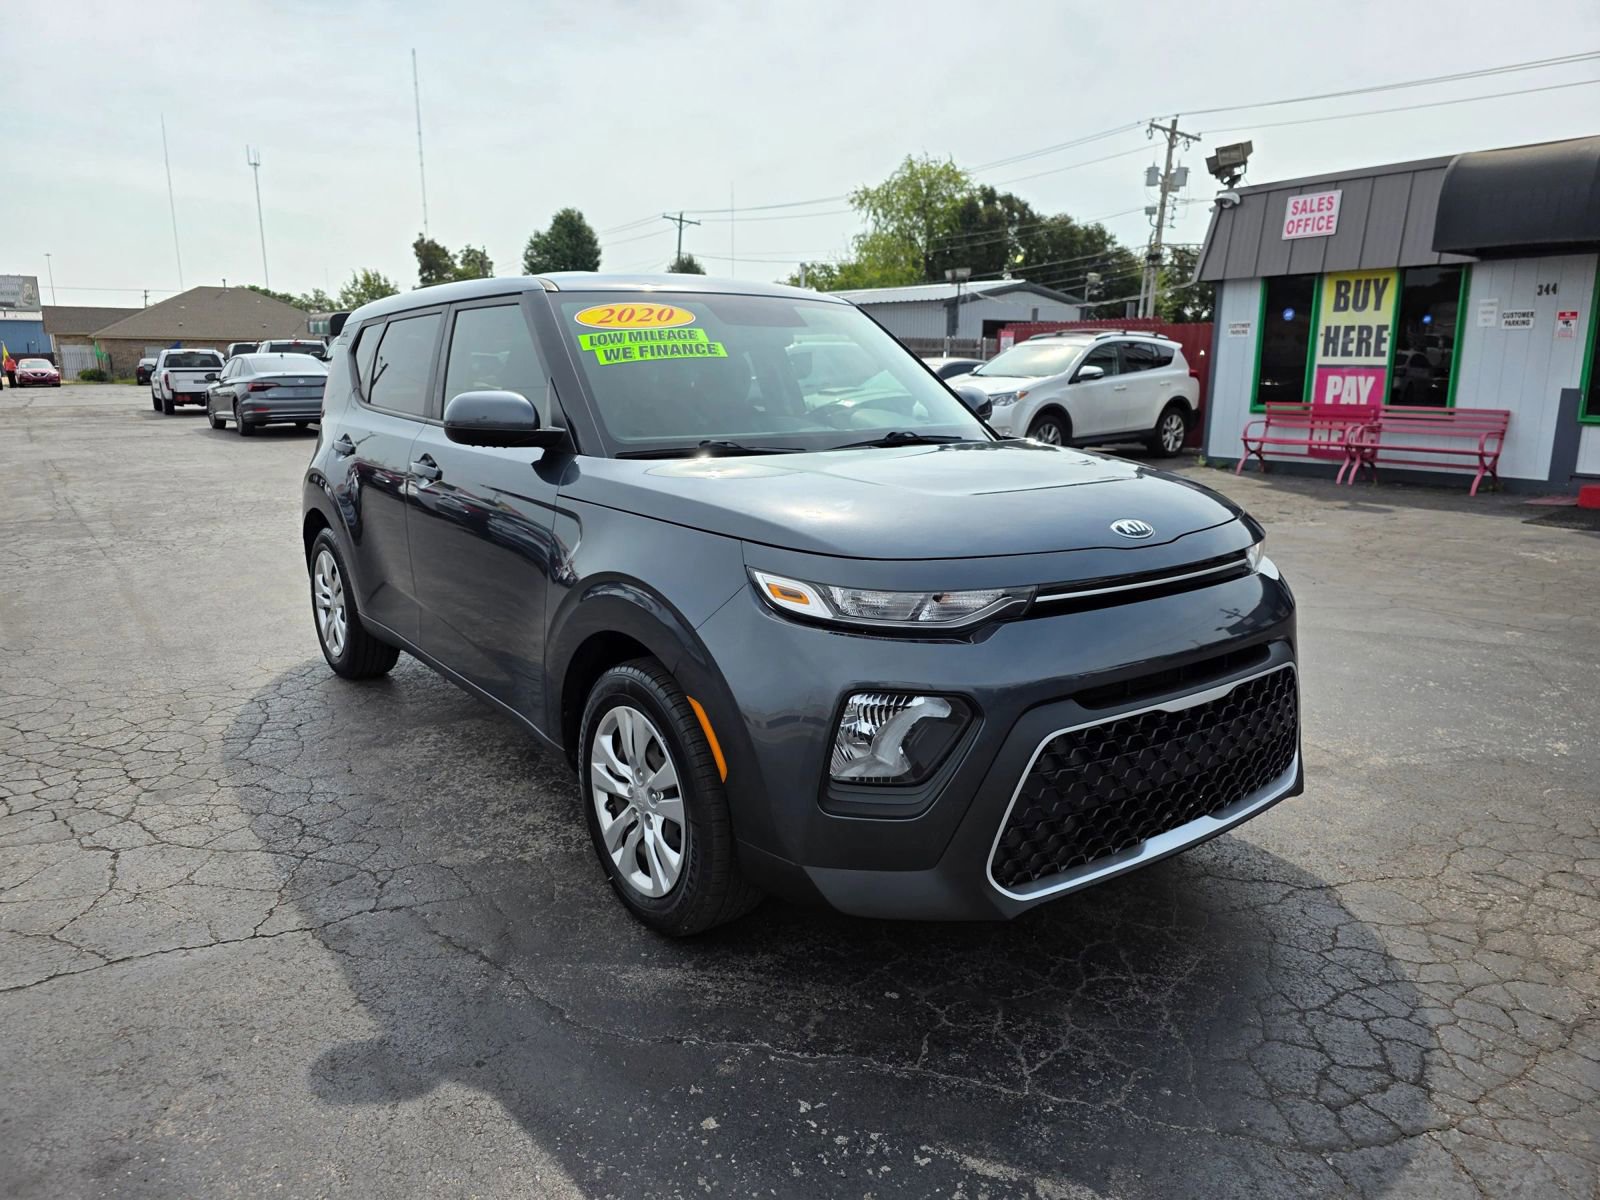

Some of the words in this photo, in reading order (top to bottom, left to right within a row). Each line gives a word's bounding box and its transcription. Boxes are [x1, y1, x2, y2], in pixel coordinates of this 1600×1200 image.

[1291, 195, 1335, 216] SALES
[1286, 214, 1335, 235] OFFICE
[1332, 277, 1391, 313] BUY
[1536, 282, 1558, 296] 344
[597, 307, 675, 324] 2020
[1502, 311, 1535, 319] CUSTOMER
[1504, 319, 1531, 327] PARKING
[589, 332, 624, 346] LOW
[628, 329, 698, 343] MILEAGE
[1322, 324, 1390, 357] HERE
[603, 346, 634, 361] WE
[639, 343, 720, 358] FINANCE
[1324, 375, 1376, 405] PAY
[1115, 519, 1152, 535] KIA
